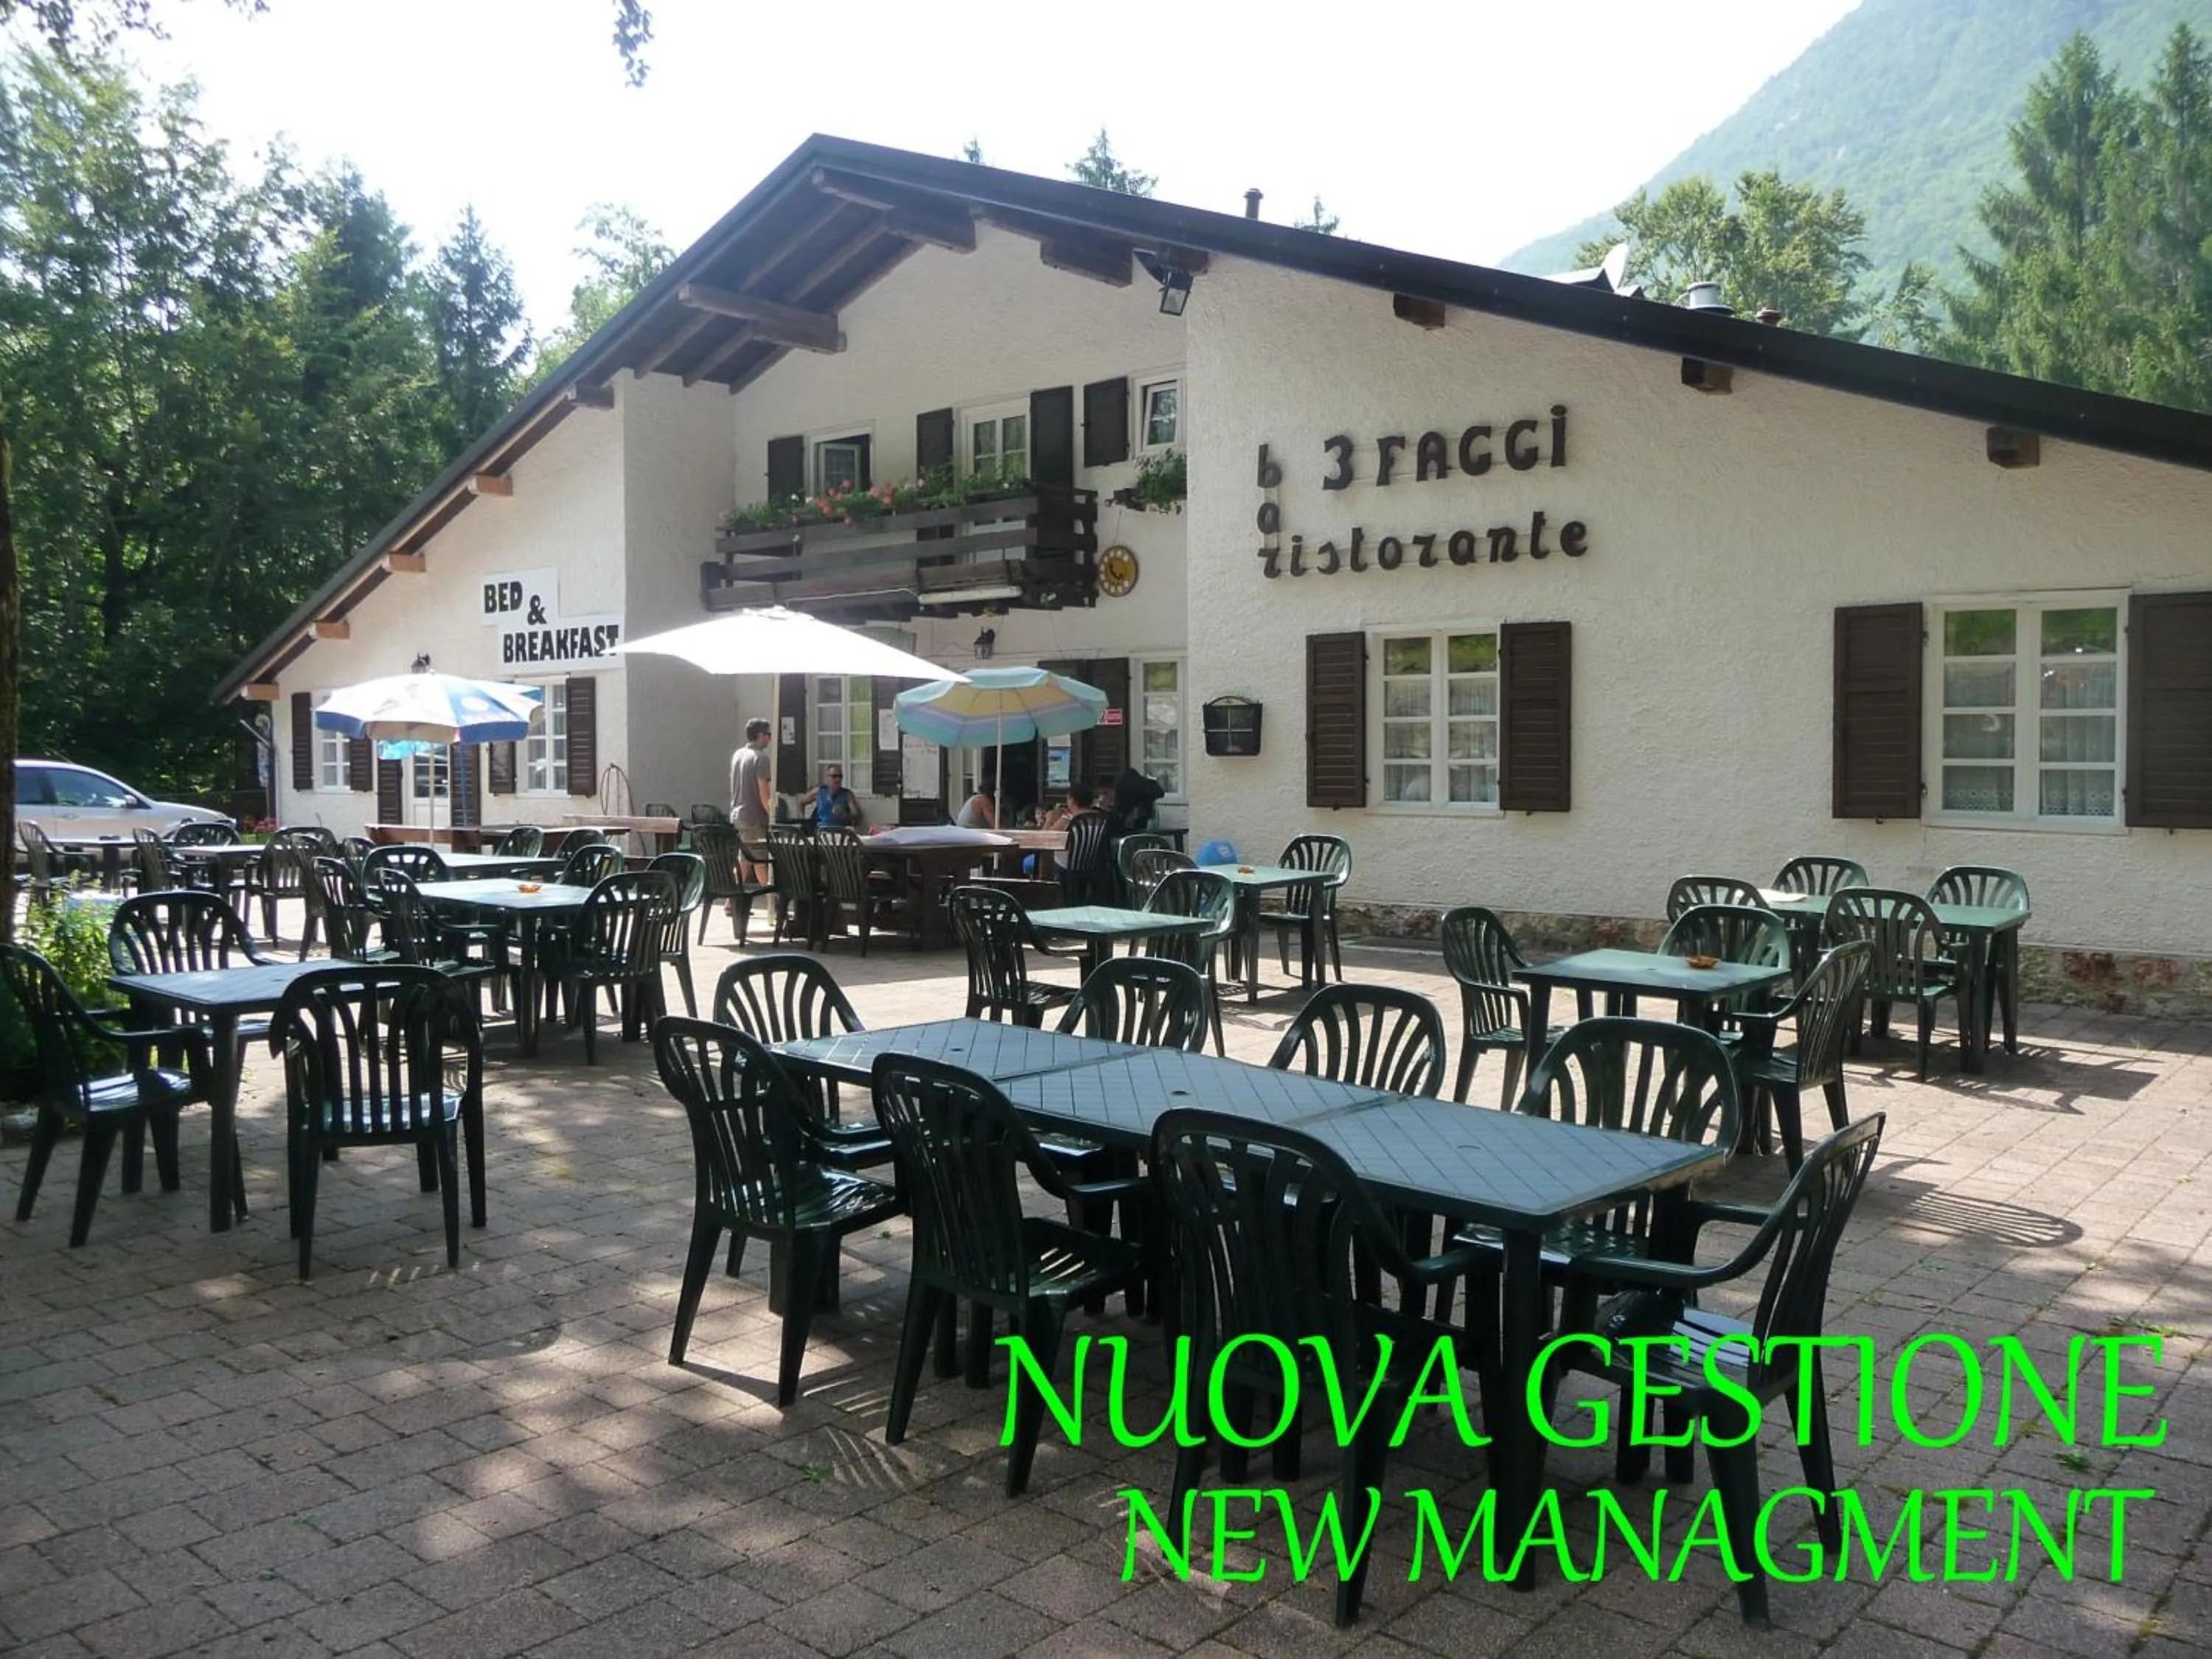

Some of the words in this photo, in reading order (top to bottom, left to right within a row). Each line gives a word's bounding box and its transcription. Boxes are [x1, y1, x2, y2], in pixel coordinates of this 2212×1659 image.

[1322, 434, 1354, 490] 3
[1257, 511, 1588, 579] ristorante
[484, 580, 523, 614] BED
[527, 594, 547, 626] &
[503, 625, 619, 664] BREAKFAST
